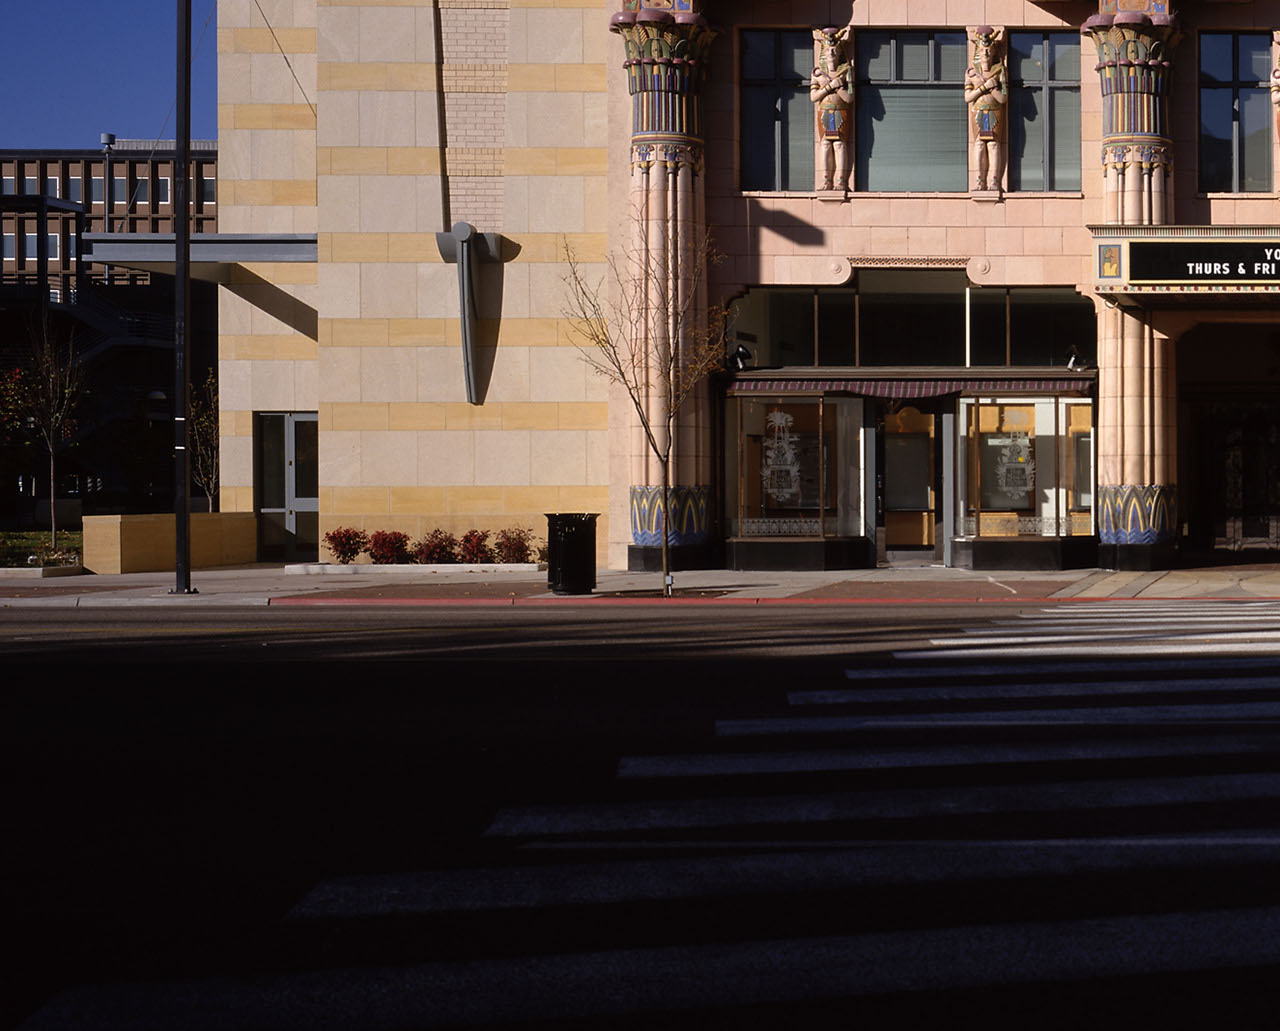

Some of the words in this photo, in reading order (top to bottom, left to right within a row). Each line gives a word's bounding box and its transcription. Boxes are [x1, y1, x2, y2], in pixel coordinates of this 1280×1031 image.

[1186, 263, 1230, 275] THURS
[1237, 263, 1246, 275] &
[1254, 263, 1276, 275] FRI
